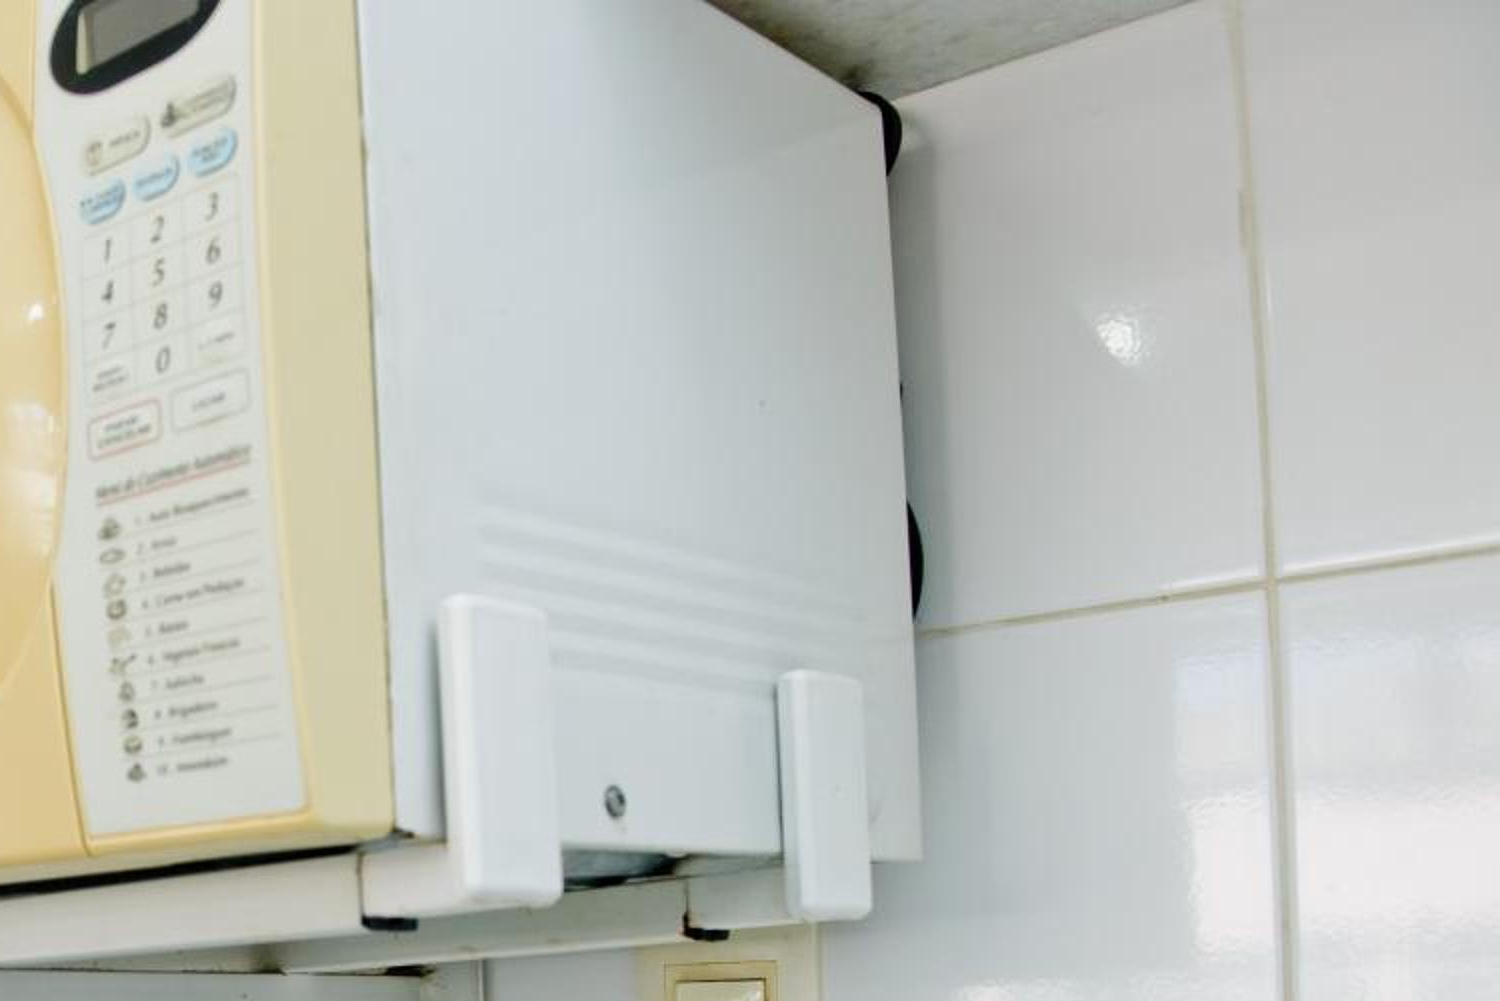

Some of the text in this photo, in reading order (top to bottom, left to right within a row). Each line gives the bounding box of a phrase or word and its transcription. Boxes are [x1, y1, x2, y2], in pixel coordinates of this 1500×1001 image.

[150, 214, 165, 244] 2
[204, 191, 219, 222] 3
[101, 236, 221, 304] 4 5 6
[102, 281, 223, 350] 7 8 9
[155, 346, 171, 374] 0
